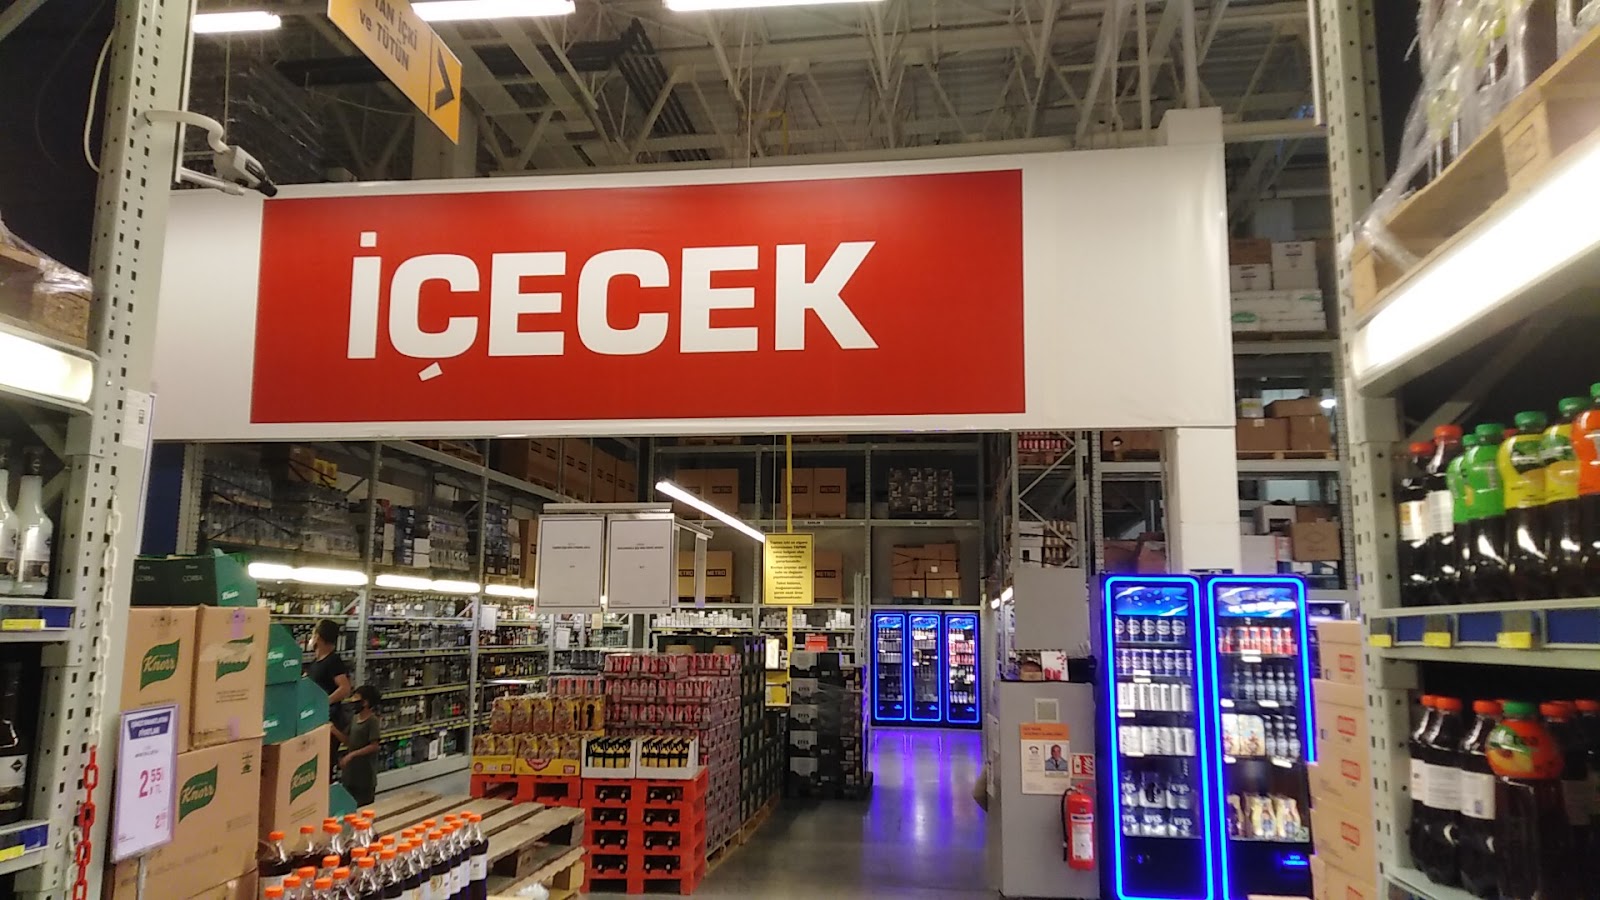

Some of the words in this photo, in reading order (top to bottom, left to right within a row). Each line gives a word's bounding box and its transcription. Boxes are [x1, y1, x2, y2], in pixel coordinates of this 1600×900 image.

[359, 8, 372, 32] ve
[376, 21, 409, 71] TÜTÜN
[347, 231, 879, 382] İÇECEK
[143, 655, 176, 673] Knorr
[181, 784, 214, 804] Knorr
